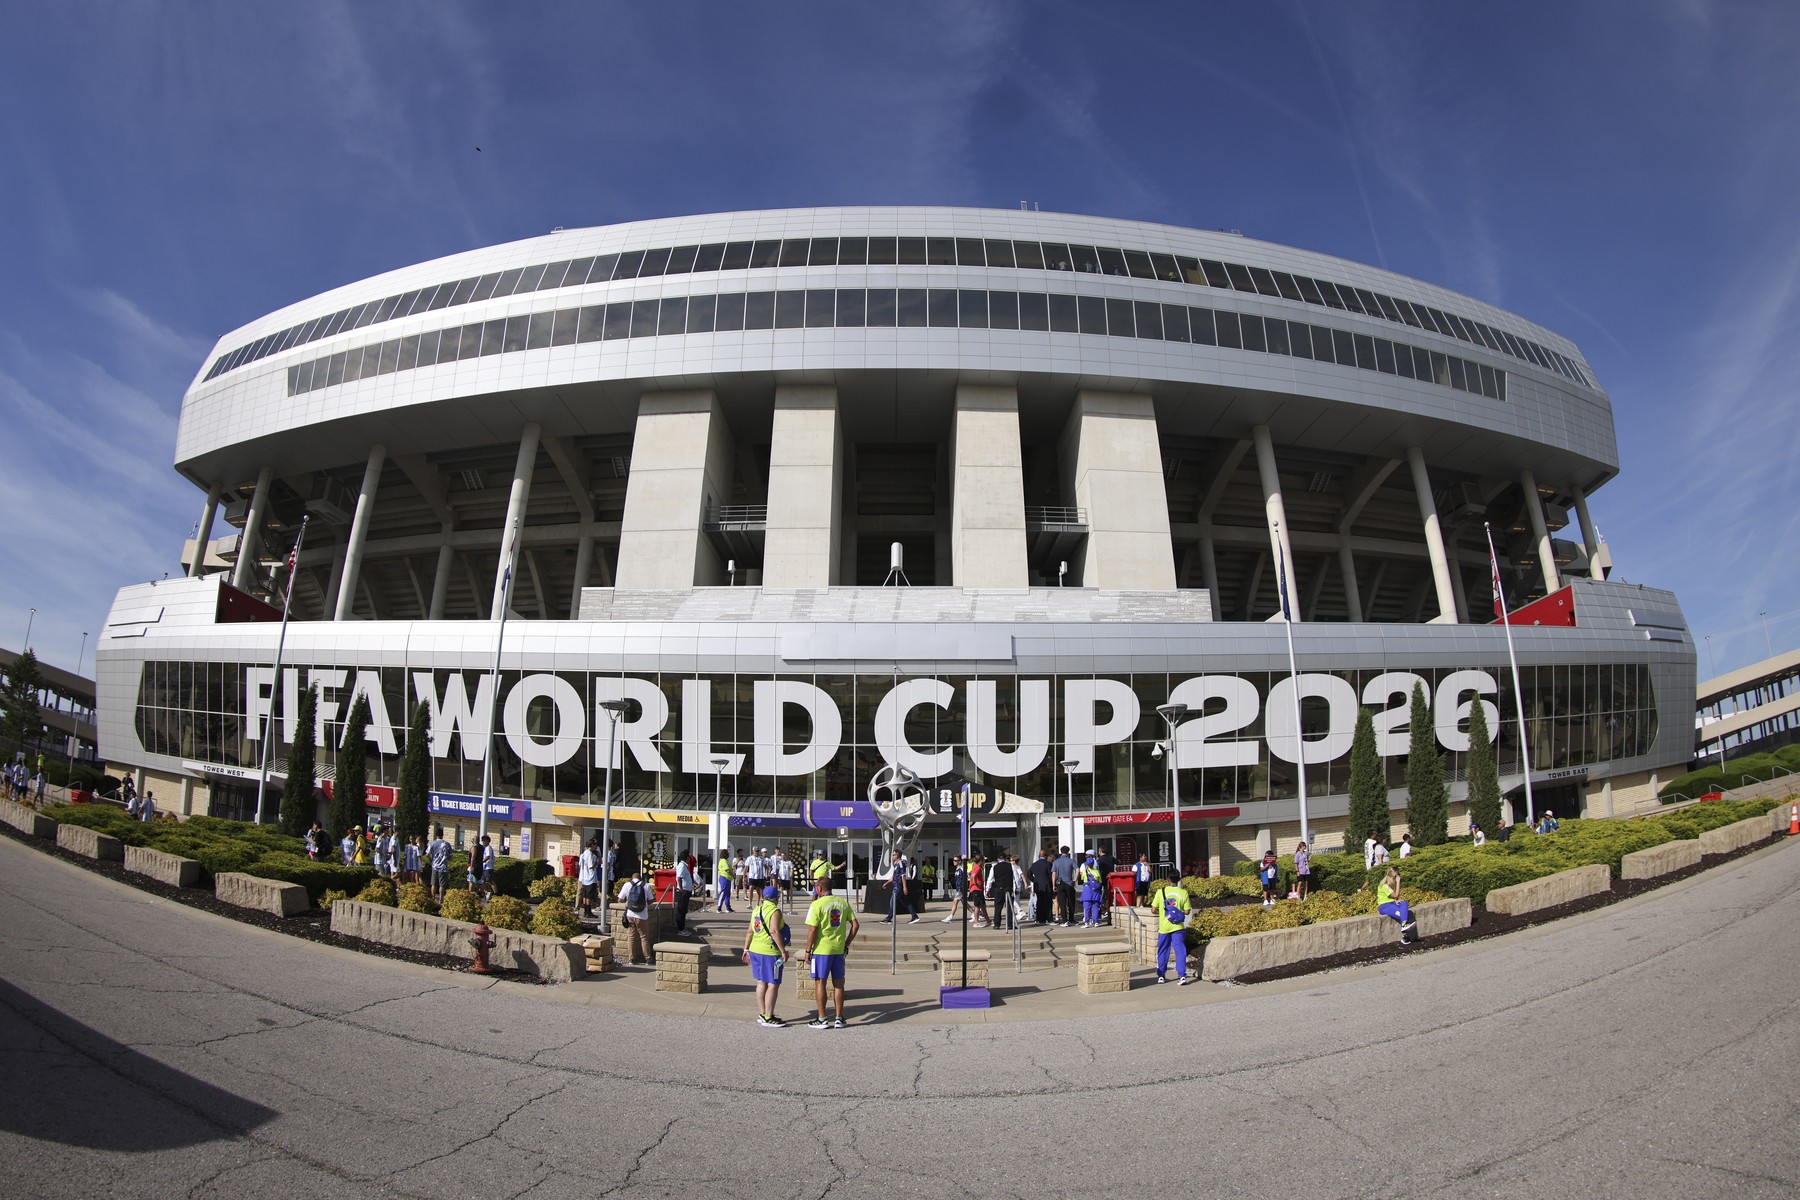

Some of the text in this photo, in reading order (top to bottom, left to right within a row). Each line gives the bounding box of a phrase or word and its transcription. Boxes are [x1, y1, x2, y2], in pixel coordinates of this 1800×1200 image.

[246, 667, 1500, 779] FIFA WORLD CUP 2026
[203, 765, 245, 777] TOWER WEST
[1548, 767, 1589, 779] TOWER EAST
[441, 799, 510, 815] TICKET RESOLUTN POINT
[840, 806, 854, 817] VIP
[677, 815, 693, 823] MEDIA
[1112, 815, 1126, 823] GATE
